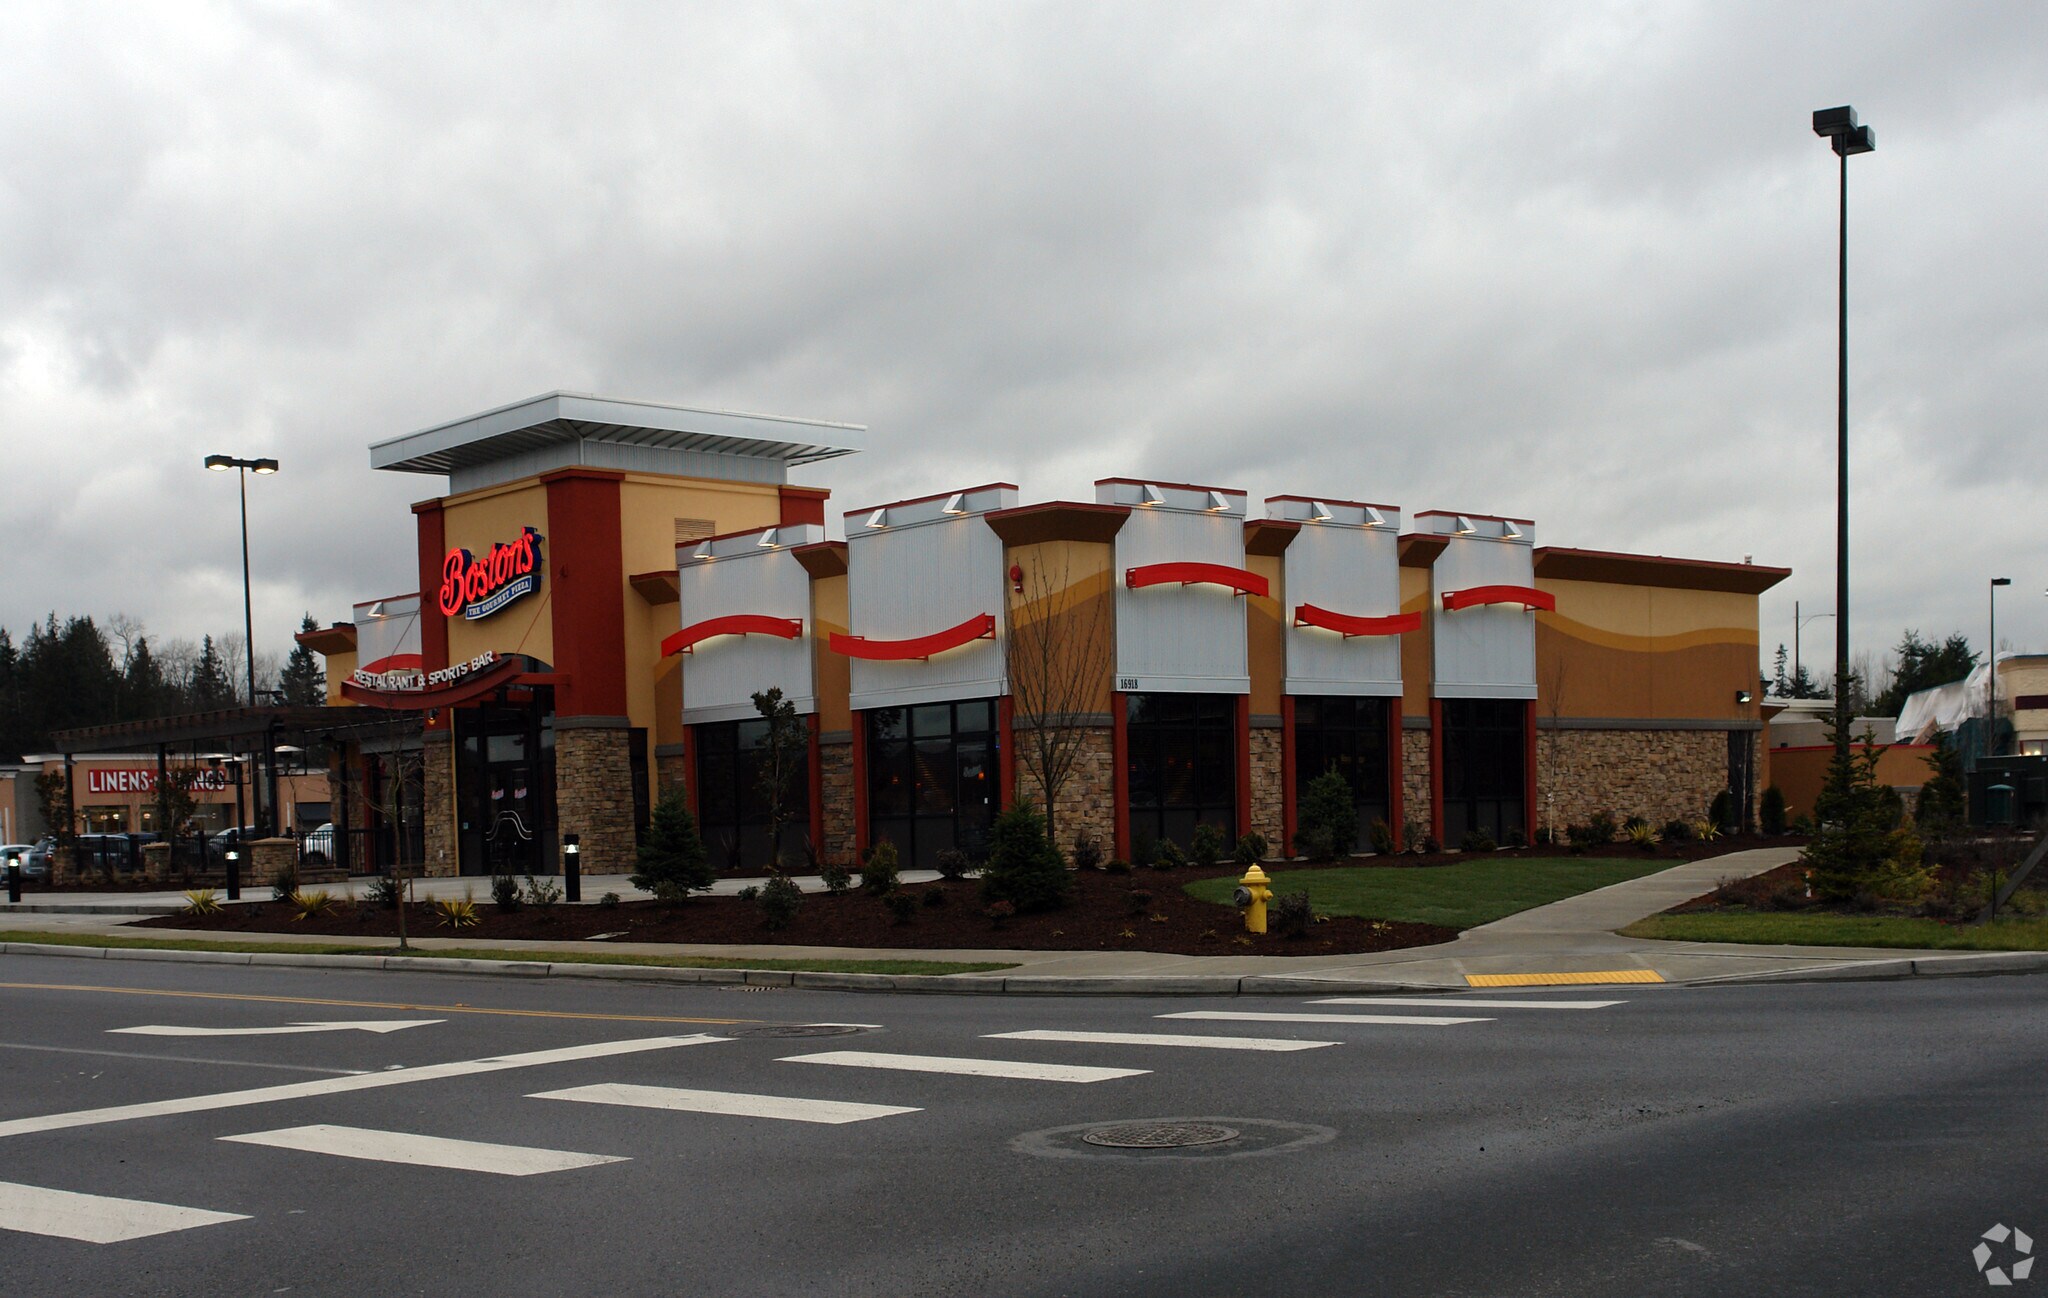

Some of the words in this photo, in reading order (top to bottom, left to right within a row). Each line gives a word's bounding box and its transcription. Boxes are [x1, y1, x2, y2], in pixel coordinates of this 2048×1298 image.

[440, 527, 534, 617] Boston's
[468, 606, 481, 616] THE
[481, 590, 510, 612] GOURMET
[511, 580, 529, 595] PIZZA
[353, 669, 415, 689] RESTAURANT
[417, 673, 426, 687] &
[428, 662, 468, 686] SPORTS
[471, 650, 494, 672] BAR
